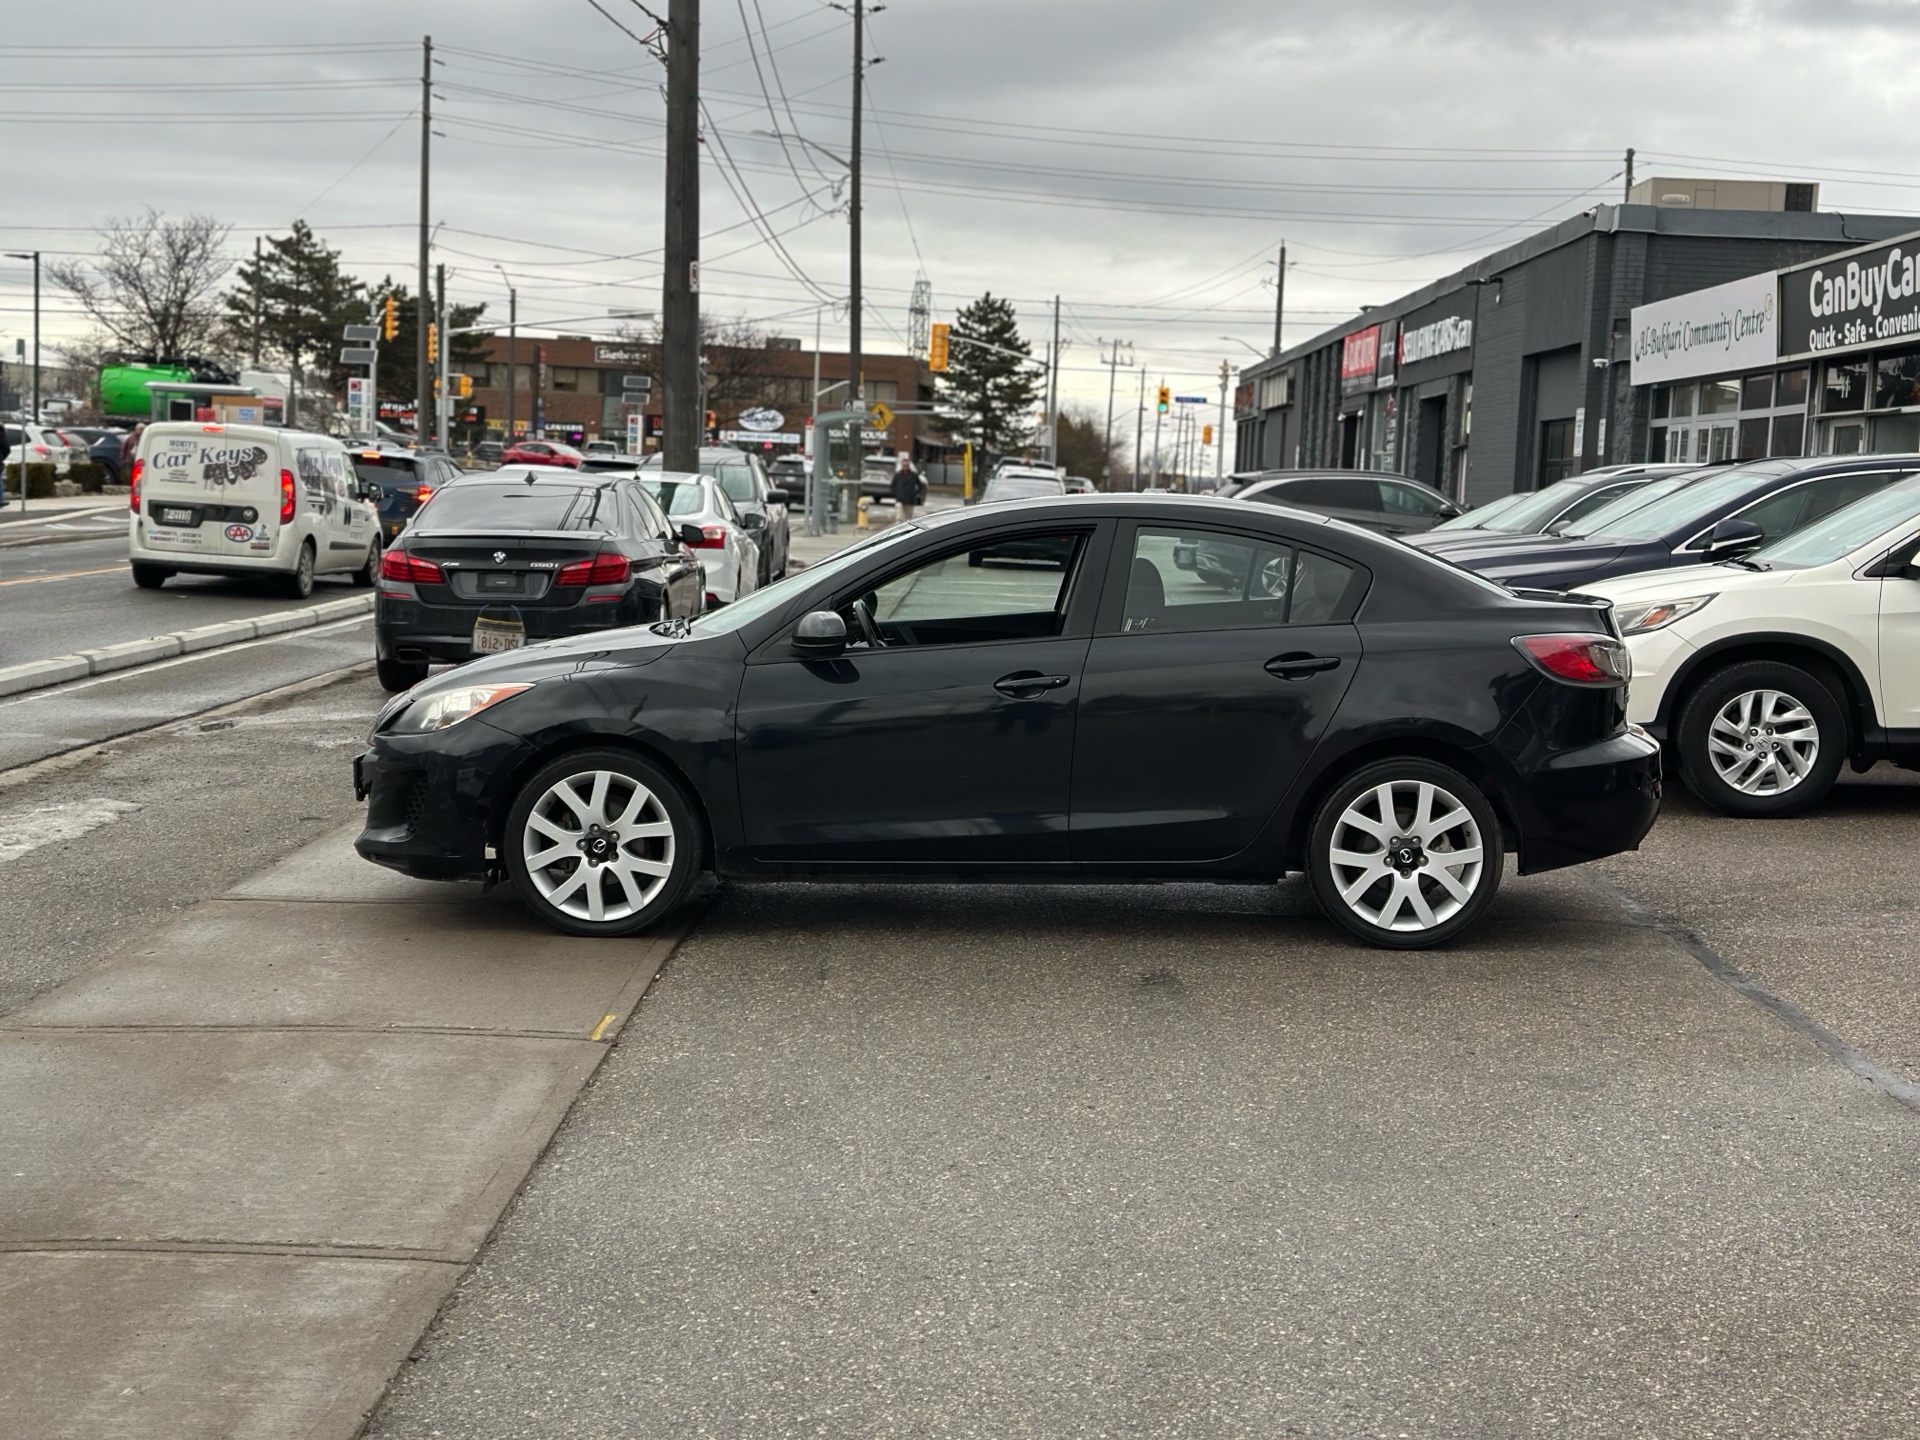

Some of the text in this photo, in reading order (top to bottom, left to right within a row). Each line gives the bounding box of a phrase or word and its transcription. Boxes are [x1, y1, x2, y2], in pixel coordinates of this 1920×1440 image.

[1634, 309, 1764, 362] Al-Bukhari Community Centre
[1809, 324, 1836, 352] Quick
[1844, 318, 1867, 345] Safe
[1875, 304, 1920, 338] Conveni
[152, 446, 253, 470] Car Keys
[228, 526, 249, 540] CAA
[481, 636, 499, 650] 812
